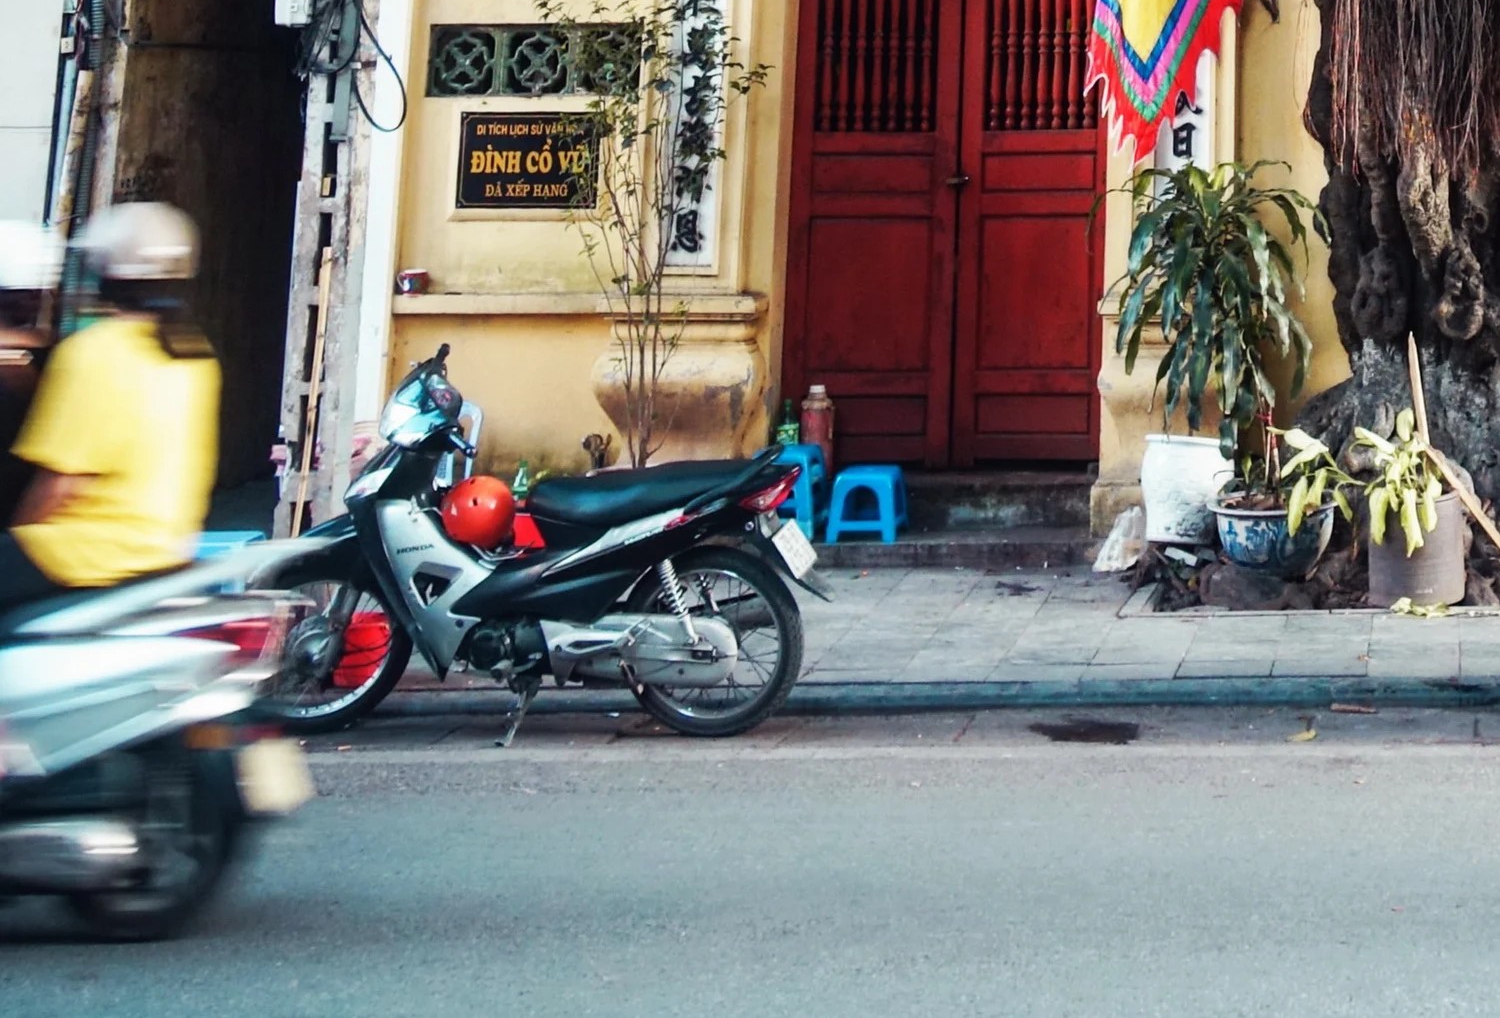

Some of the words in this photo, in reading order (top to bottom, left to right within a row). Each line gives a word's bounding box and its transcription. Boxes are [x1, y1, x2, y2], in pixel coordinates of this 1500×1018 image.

[476, 124, 486, 135] DI
[488, 122, 507, 135] TÍCH
[510, 124, 529, 138] LỊCH
[470, 144, 522, 173] ĐÌNH
[526, 136, 553, 174] CỔ
[558, 144, 587, 173] VŨ
[506, 178, 531, 197] XẾP
[533, 183, 569, 200] HẠNG
[396, 544, 434, 554] HONDA
